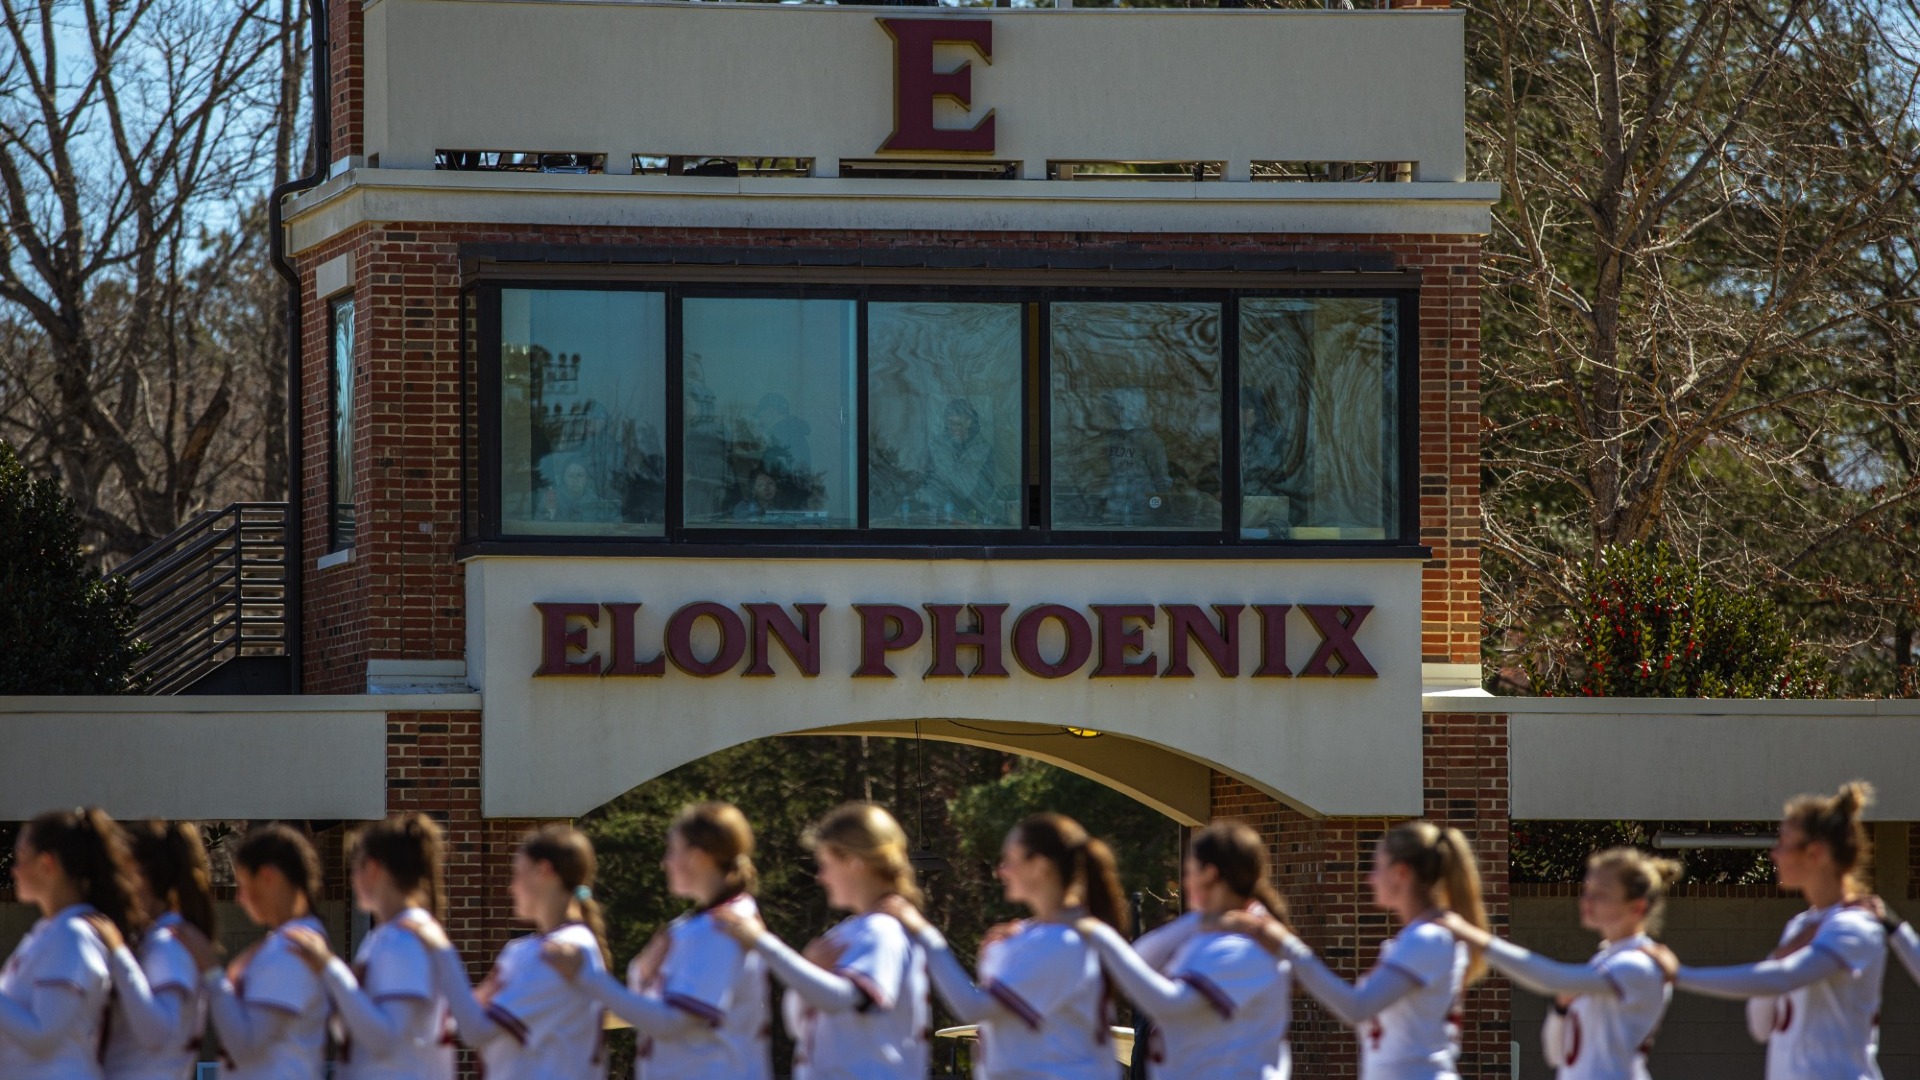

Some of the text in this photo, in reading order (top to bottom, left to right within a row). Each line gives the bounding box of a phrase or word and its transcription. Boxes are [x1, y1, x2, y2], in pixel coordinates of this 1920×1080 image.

[875, 17, 995, 156] E
[533, 602, 1379, 679] ELON PHOENIX
